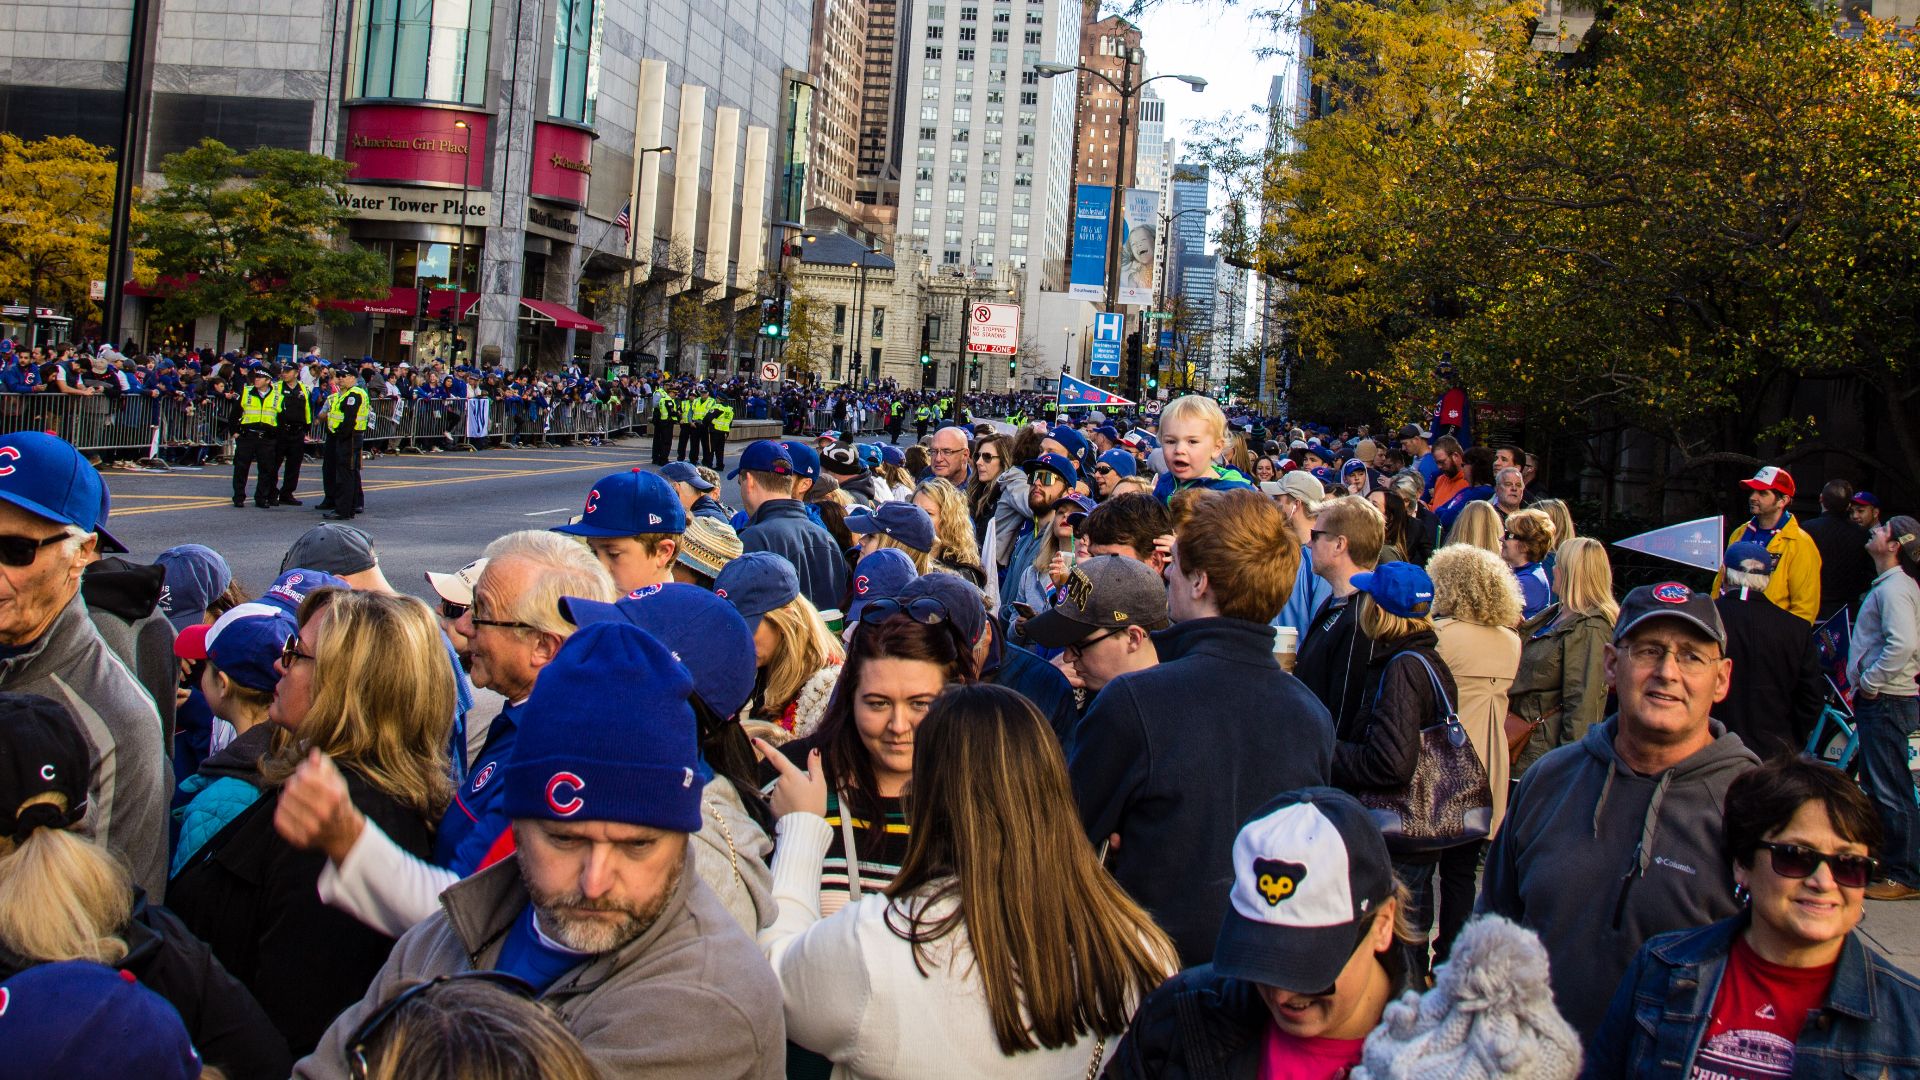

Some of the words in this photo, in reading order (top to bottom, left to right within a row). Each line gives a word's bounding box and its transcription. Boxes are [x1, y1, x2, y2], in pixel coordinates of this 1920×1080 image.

[359, 135, 409, 149] American
[413, 138, 435, 151] Girl
[336, 193, 384, 210] Water
[388, 196, 438, 213] Tower
[1097, 314, 1119, 340] H
[586, 489, 600, 513] C
[856, 575, 869, 595] C
[41, 764, 56, 780] C
[545, 771, 585, 816] C
